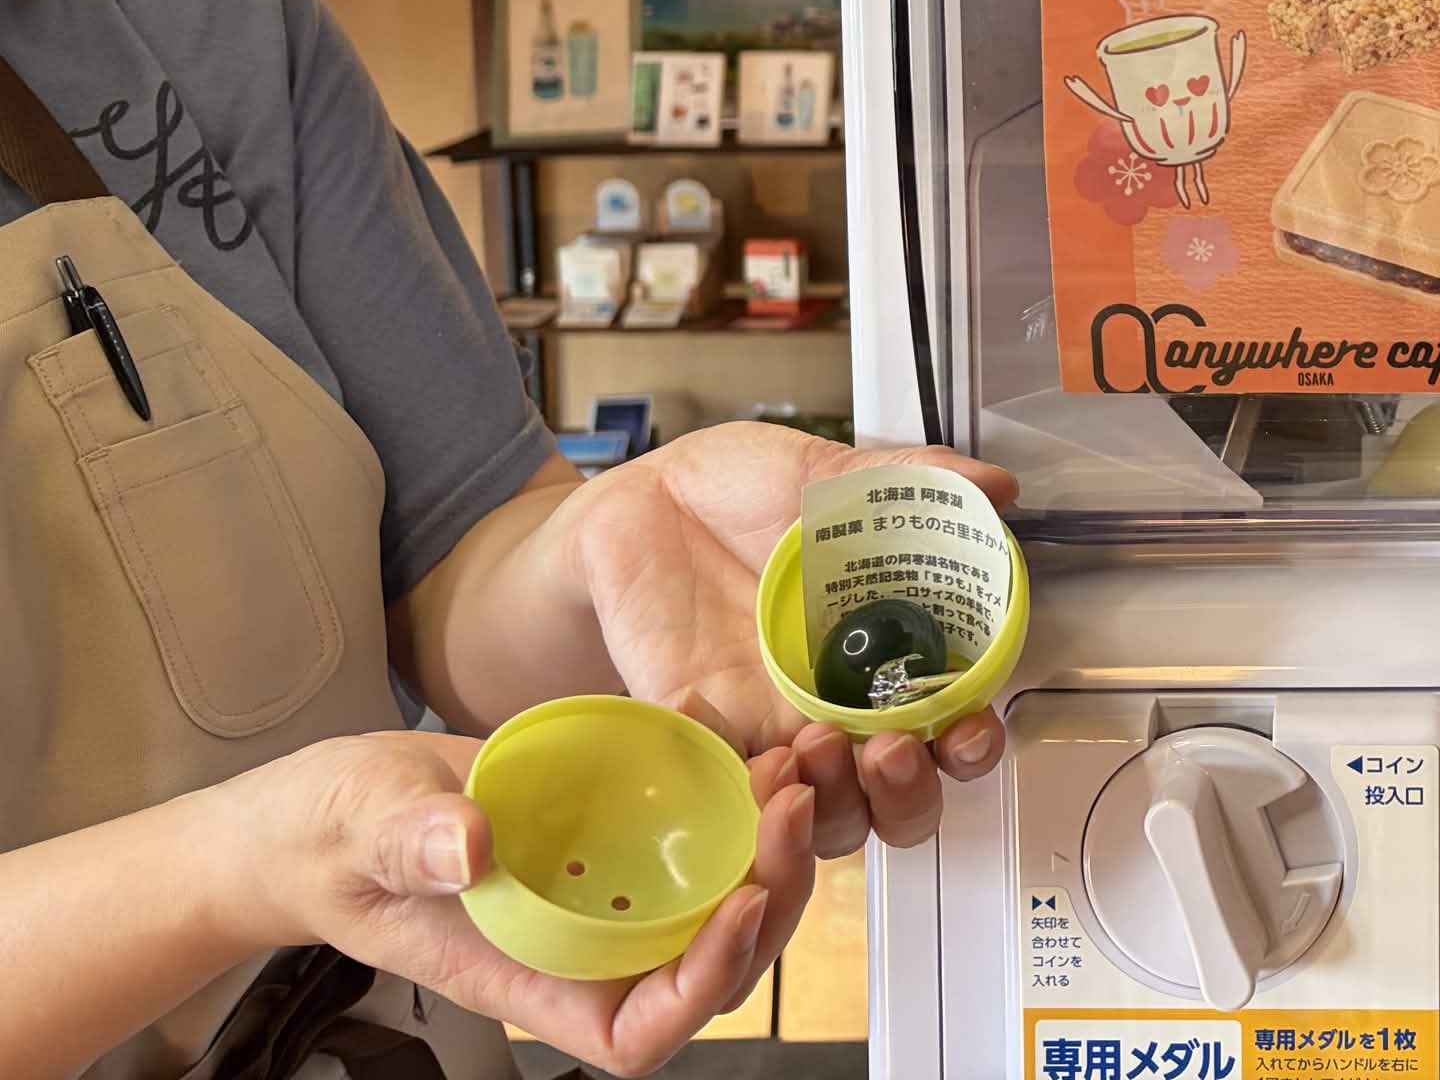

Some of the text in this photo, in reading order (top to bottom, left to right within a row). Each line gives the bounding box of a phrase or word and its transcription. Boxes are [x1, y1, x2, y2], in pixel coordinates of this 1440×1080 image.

[1164, 326, 1377, 387] anywhere
[1297, 372, 1334, 386] OSAKA
[865, 486, 964, 510] 北海道 阿寒湖
[1364, 755, 1425, 775] コイン
[1364, 784, 1425, 806] 投入口
[1031, 917, 1071, 931] 矢印を
[1031, 936, 1083, 951] 合わせて
[1031, 955, 1083, 969] コインを
[1031, 975, 1071, 988] 入れる
[1042, 1037, 1236, 1080] 専用メダル
[1255, 1057, 1419, 1072] 入れてからハンドルを右に
